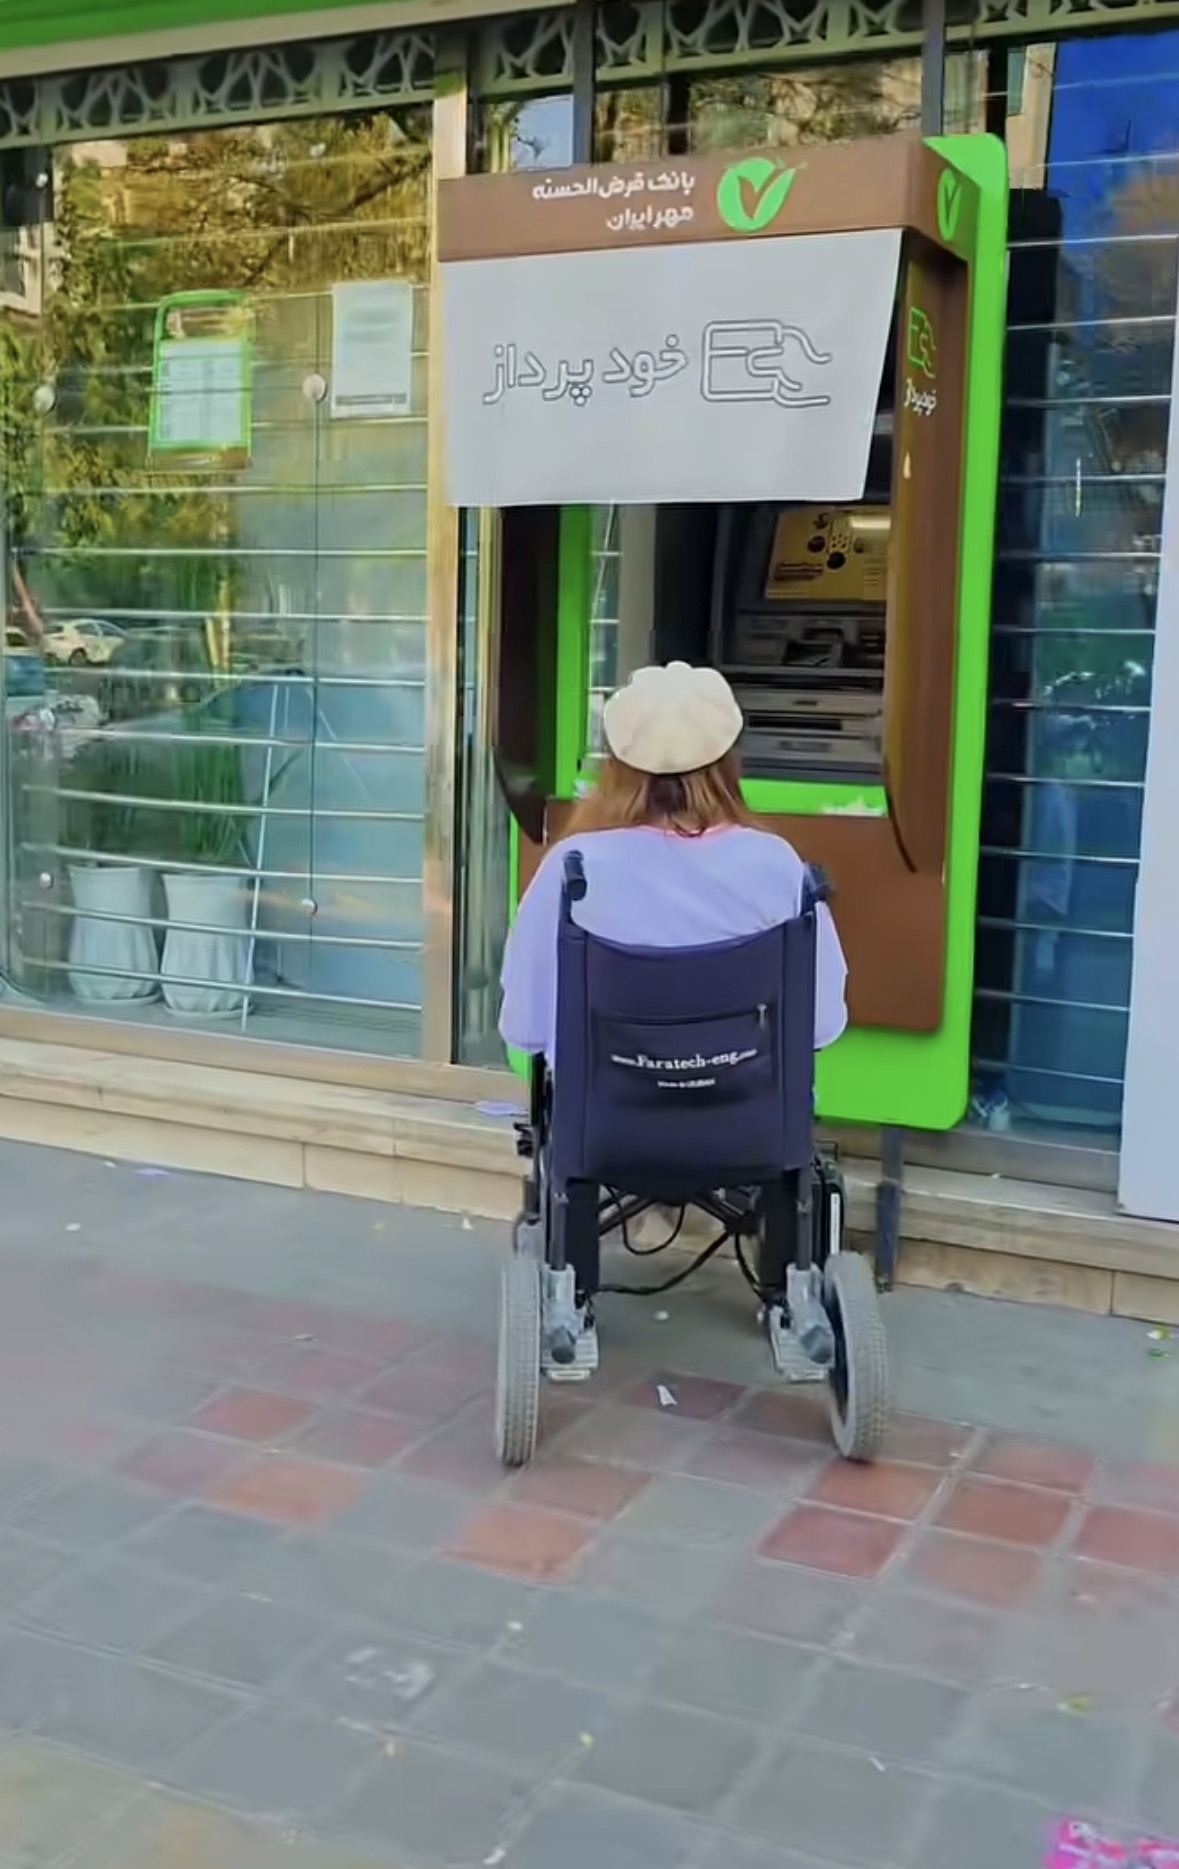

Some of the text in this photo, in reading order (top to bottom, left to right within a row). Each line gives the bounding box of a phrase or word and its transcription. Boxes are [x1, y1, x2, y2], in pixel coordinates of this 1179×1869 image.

[647, 171, 696, 196] بانک
[606, 204, 695, 231] مهر ایران
[482, 333, 690, 407] خود پرداز
